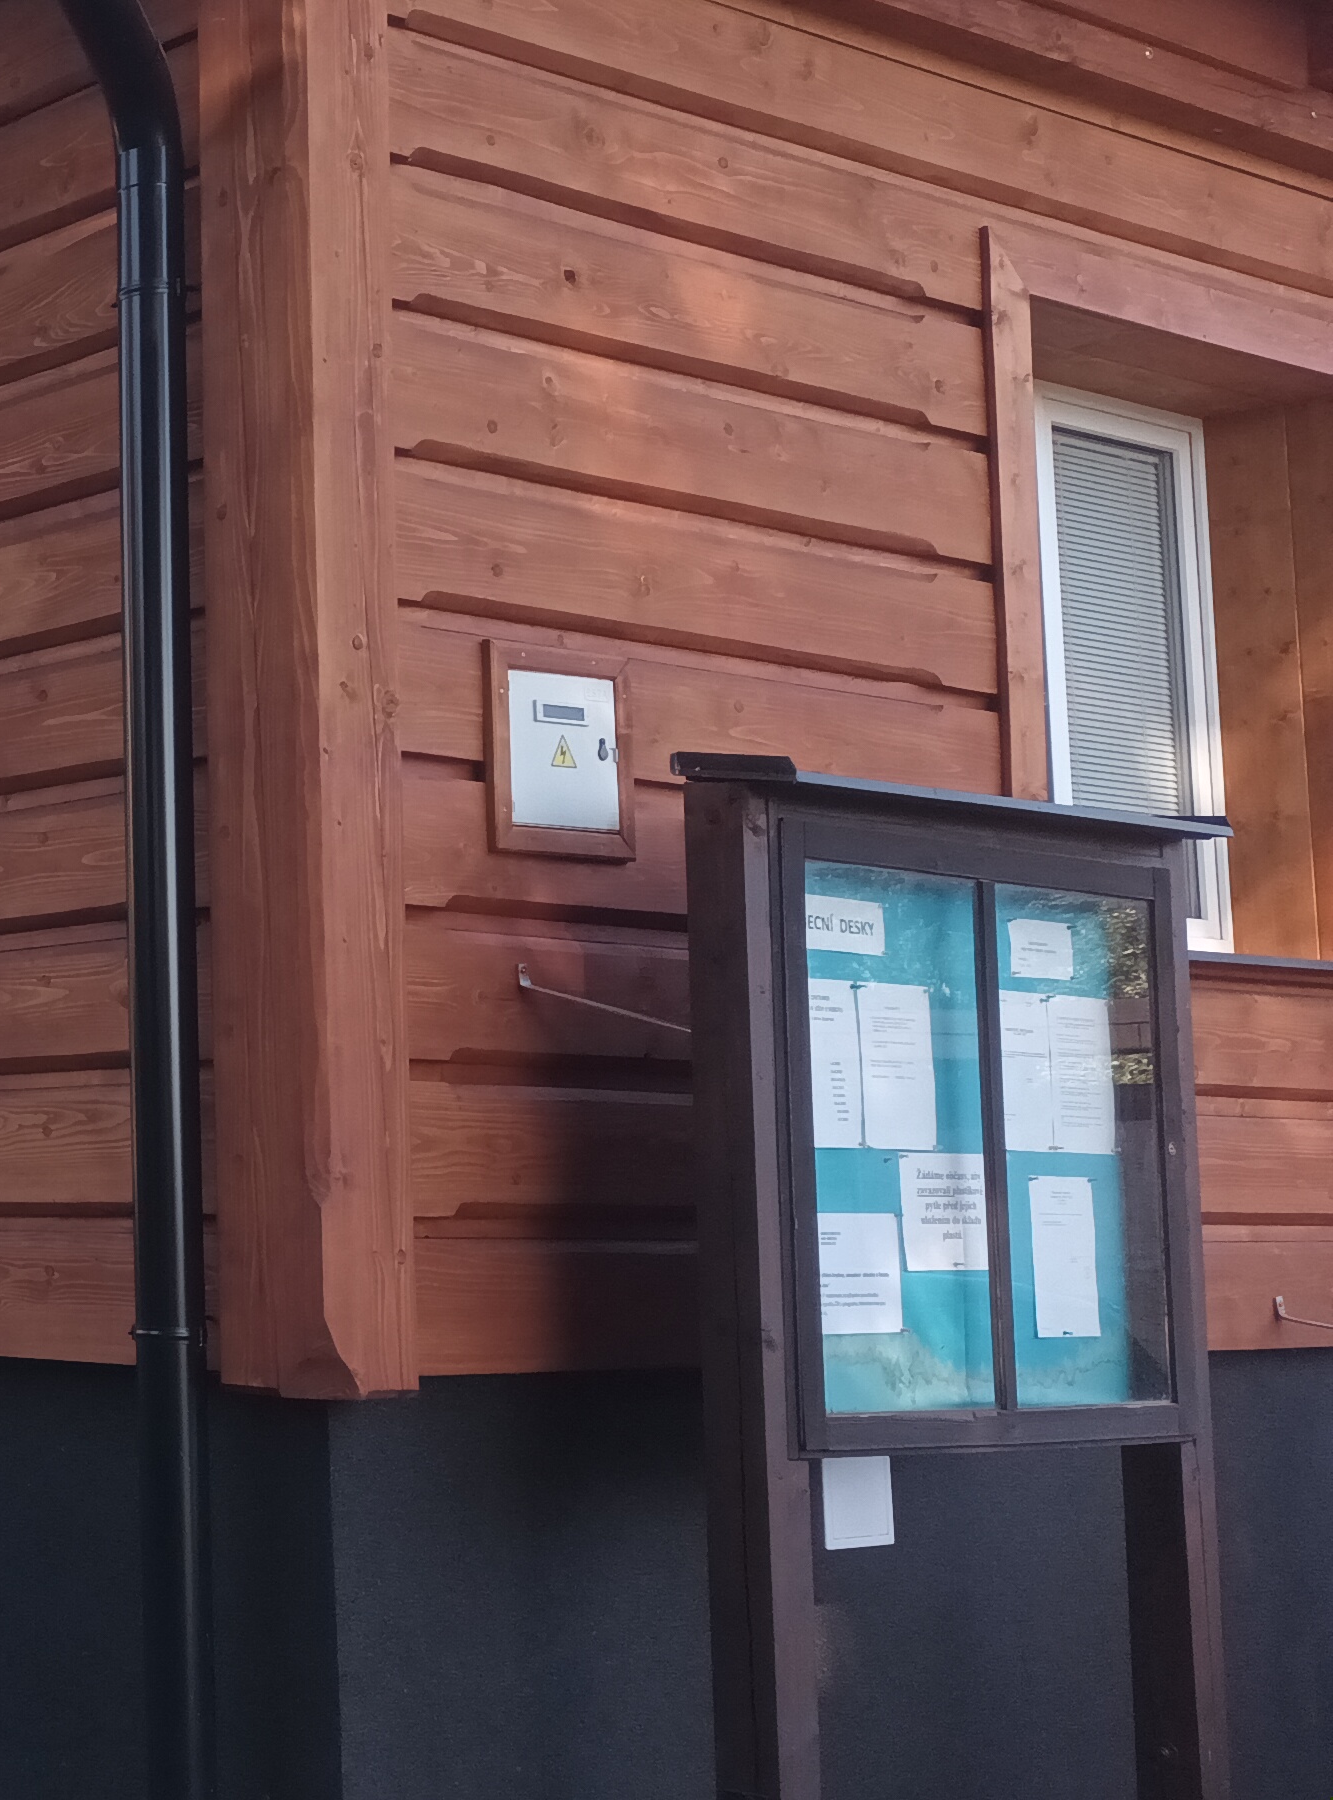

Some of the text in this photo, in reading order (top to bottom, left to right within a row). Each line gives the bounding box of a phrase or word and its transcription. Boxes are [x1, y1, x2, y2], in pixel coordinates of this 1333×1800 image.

[807, 913, 874, 936] ECNÍ DESKY
[951, 1215, 961, 1225] do
